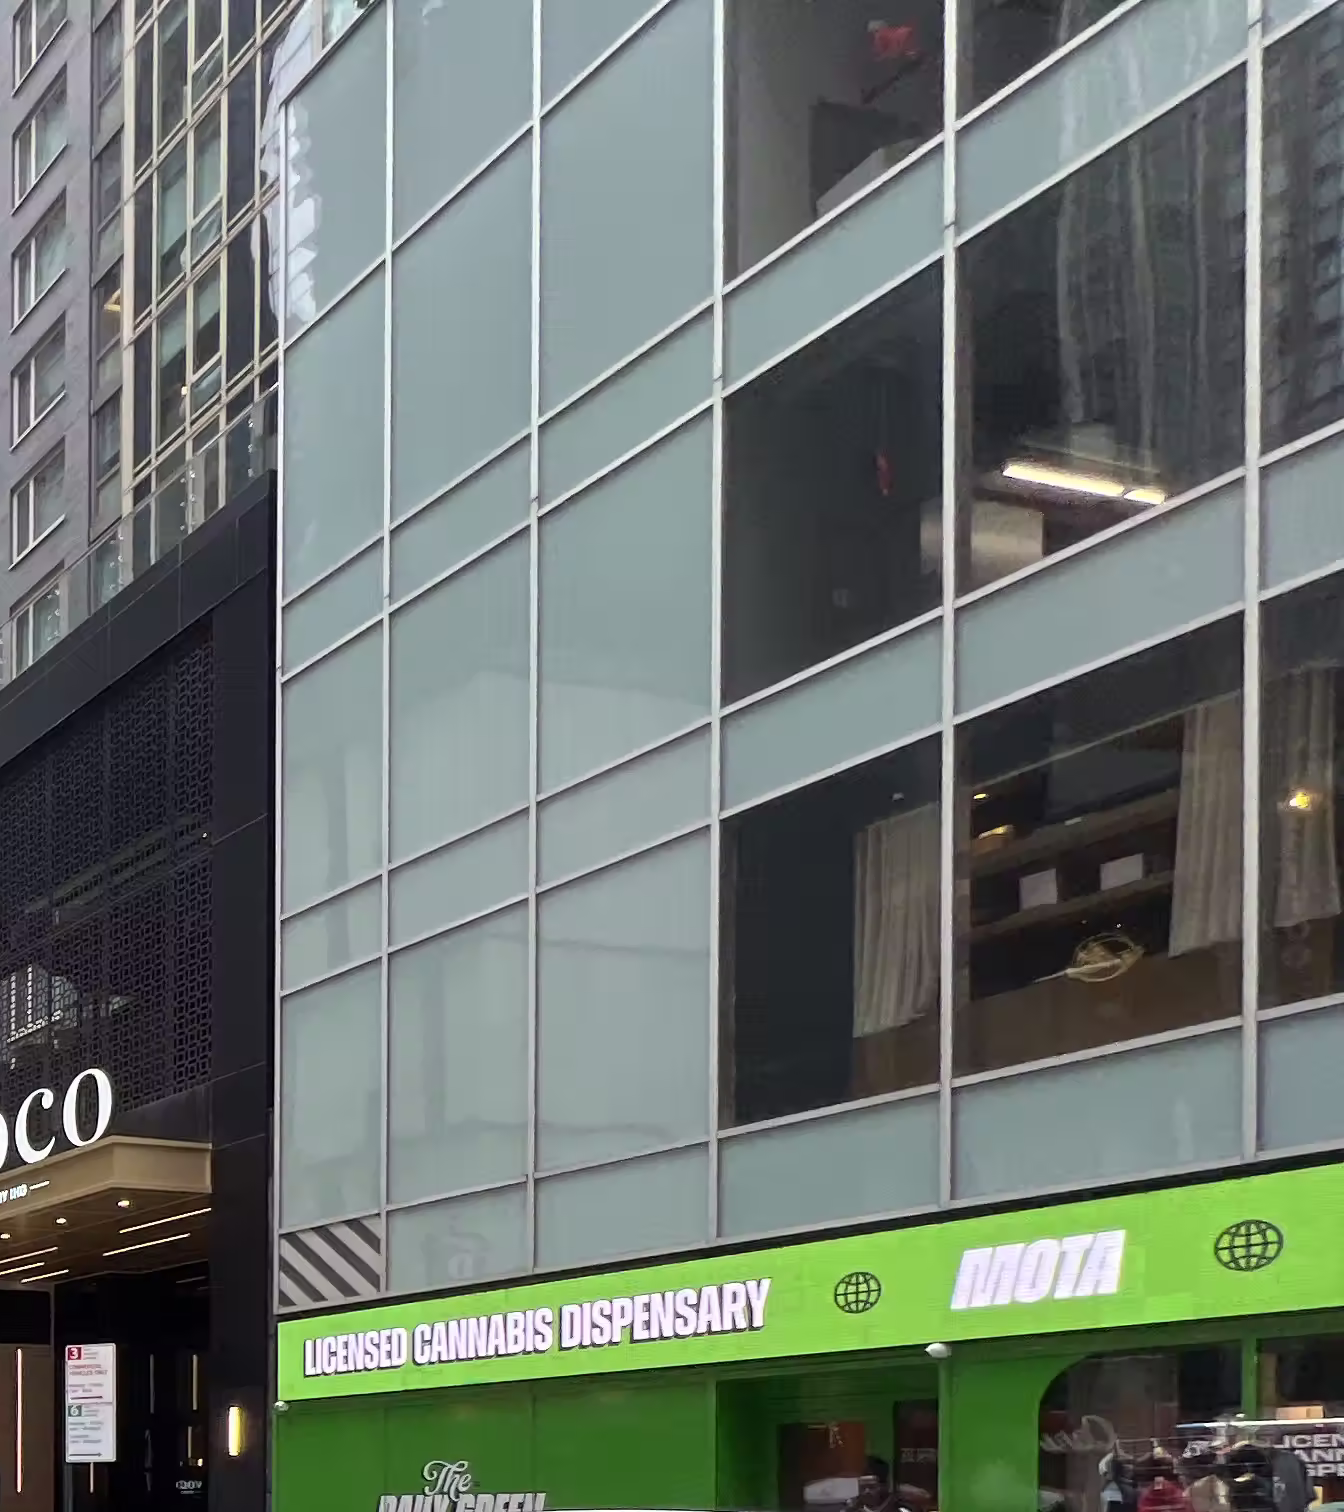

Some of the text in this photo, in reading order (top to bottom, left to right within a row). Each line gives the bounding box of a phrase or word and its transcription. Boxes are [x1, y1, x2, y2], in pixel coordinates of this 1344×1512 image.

[304, 1277, 772, 1378] LICENSED CANNABIS DISPENSARY
[422, 1460, 473, 1502] The
